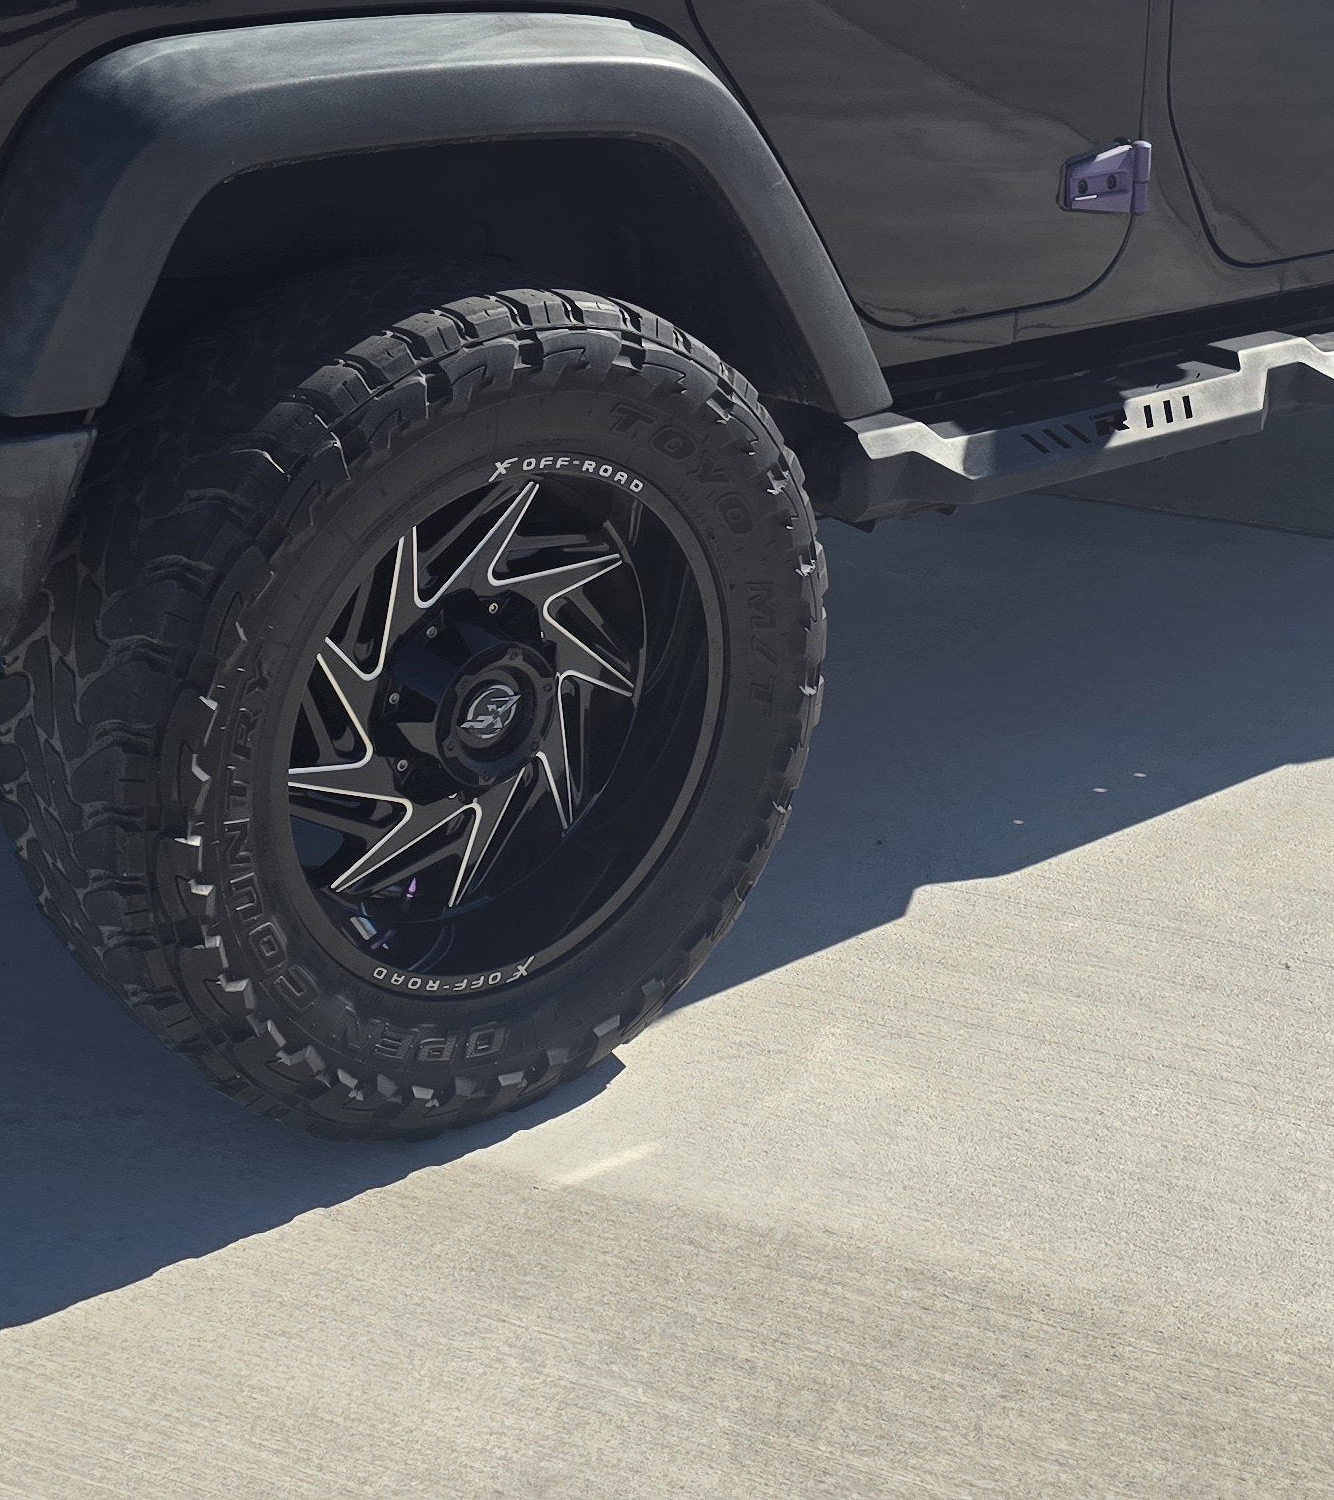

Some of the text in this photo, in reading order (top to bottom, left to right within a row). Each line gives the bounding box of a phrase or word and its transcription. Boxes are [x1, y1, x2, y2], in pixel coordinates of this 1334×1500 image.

[522, 456, 644, 494] OFF-ROAD
[608, 398, 755, 536] TOYO
[373, 967, 502, 992] OFF-ROAD
